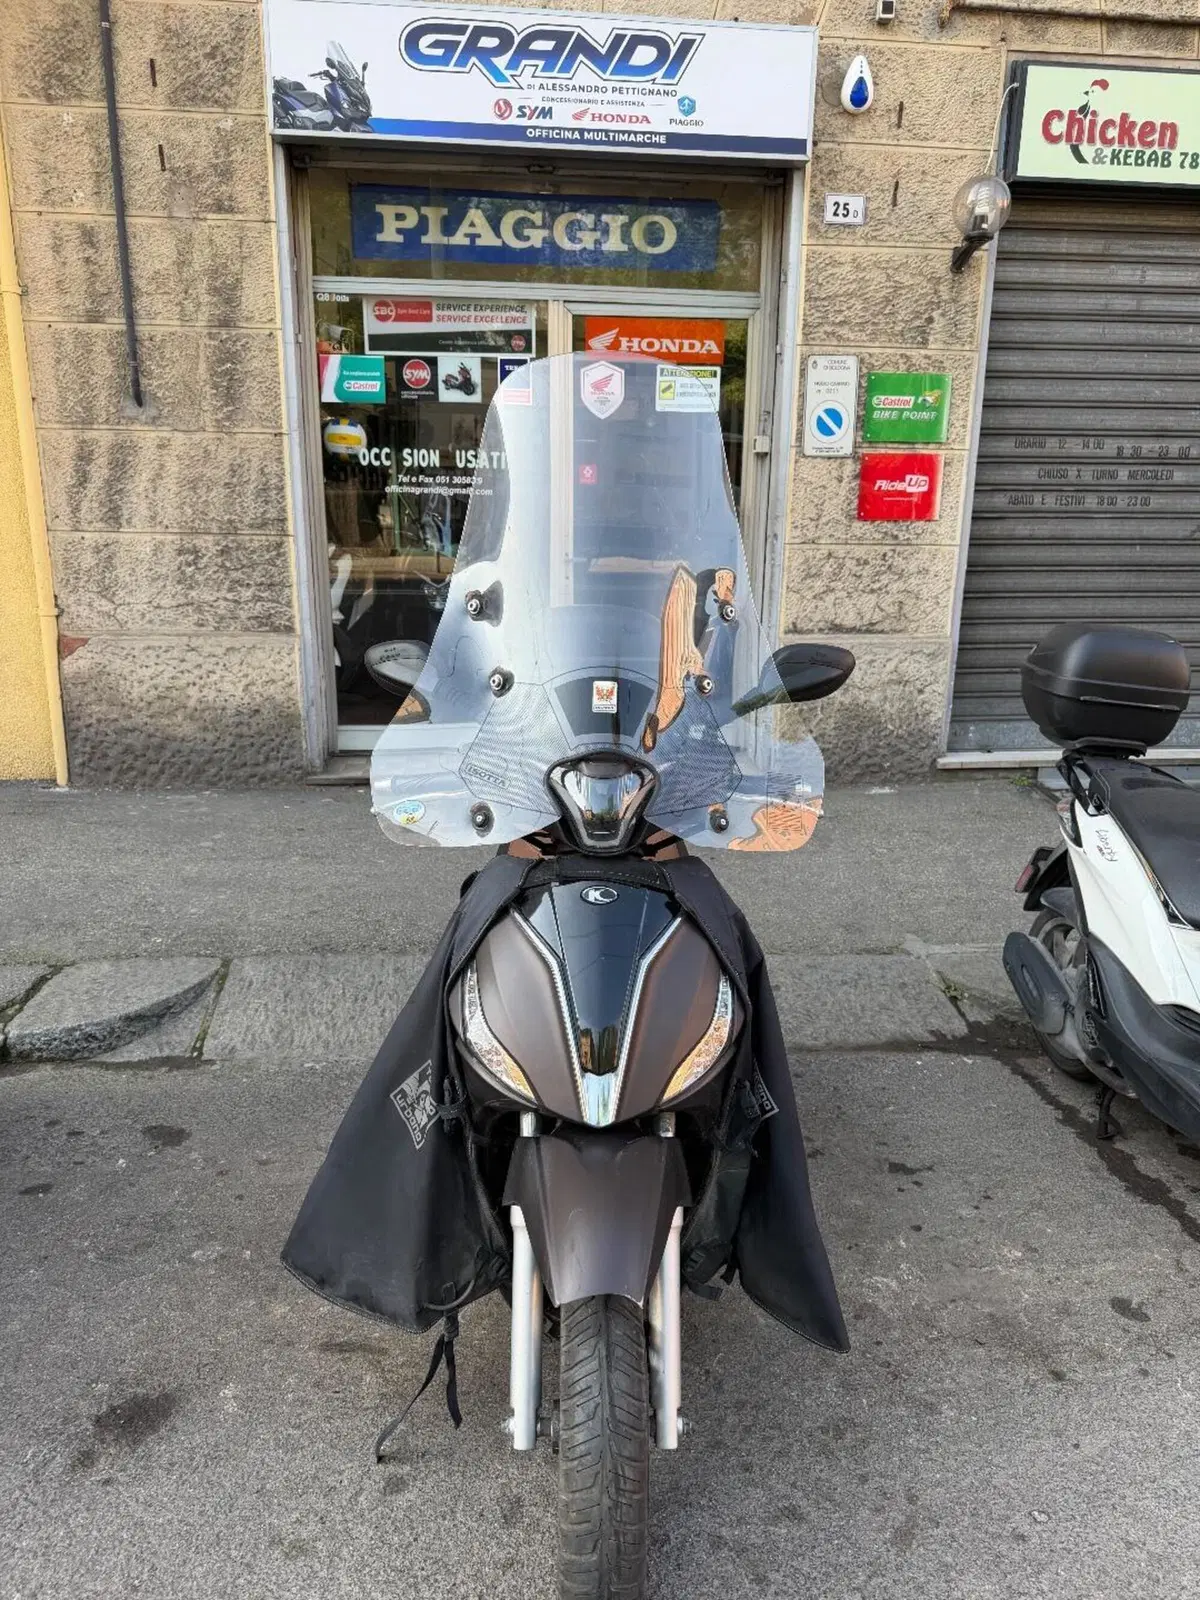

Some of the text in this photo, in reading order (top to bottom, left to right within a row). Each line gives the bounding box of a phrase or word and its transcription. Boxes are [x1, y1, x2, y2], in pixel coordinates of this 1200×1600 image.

[401, 20, 703, 88] GRANDI
[538, 84, 608, 94] ALESSANDRO
[611, 86, 678, 98] PETTIGNANO
[516, 105, 553, 120] SYM
[591, 112, 651, 124] HONDA
[669, 118, 704, 127] PIAGGIO
[526, 128, 667, 144] OFFICINA MULTIMARCHE
[1041, 109, 1179, 150] Chicken
[1179, 151, 1200, 170] 78
[832, 201, 850, 218] 25
[374, 203, 678, 255] PIAGGIO
[435, 303, 472, 312] SERVICE
[435, 314, 528, 324] SERVICE EXCELLENCE
[619, 337, 721, 354] HONDA
[405, 369, 429, 381] SYM
[352, 382, 378, 391] Castrol
[882, 396, 912, 407] Castrol
[872, 410, 937, 420] BIKE POINT
[1014, 436, 1047, 449] ORARIO
[402, 448, 440, 467] SION
[419, 475, 433, 483] Fax
[435, 476, 451, 484] 051
[1038, 468, 1174, 481] CHIUSO X TURNO MERCOLEDI
[1041, 494, 1048, 506] E
[1054, 495, 1086, 507] FESTIVI
[468, 765, 507, 787] ISOTTA
